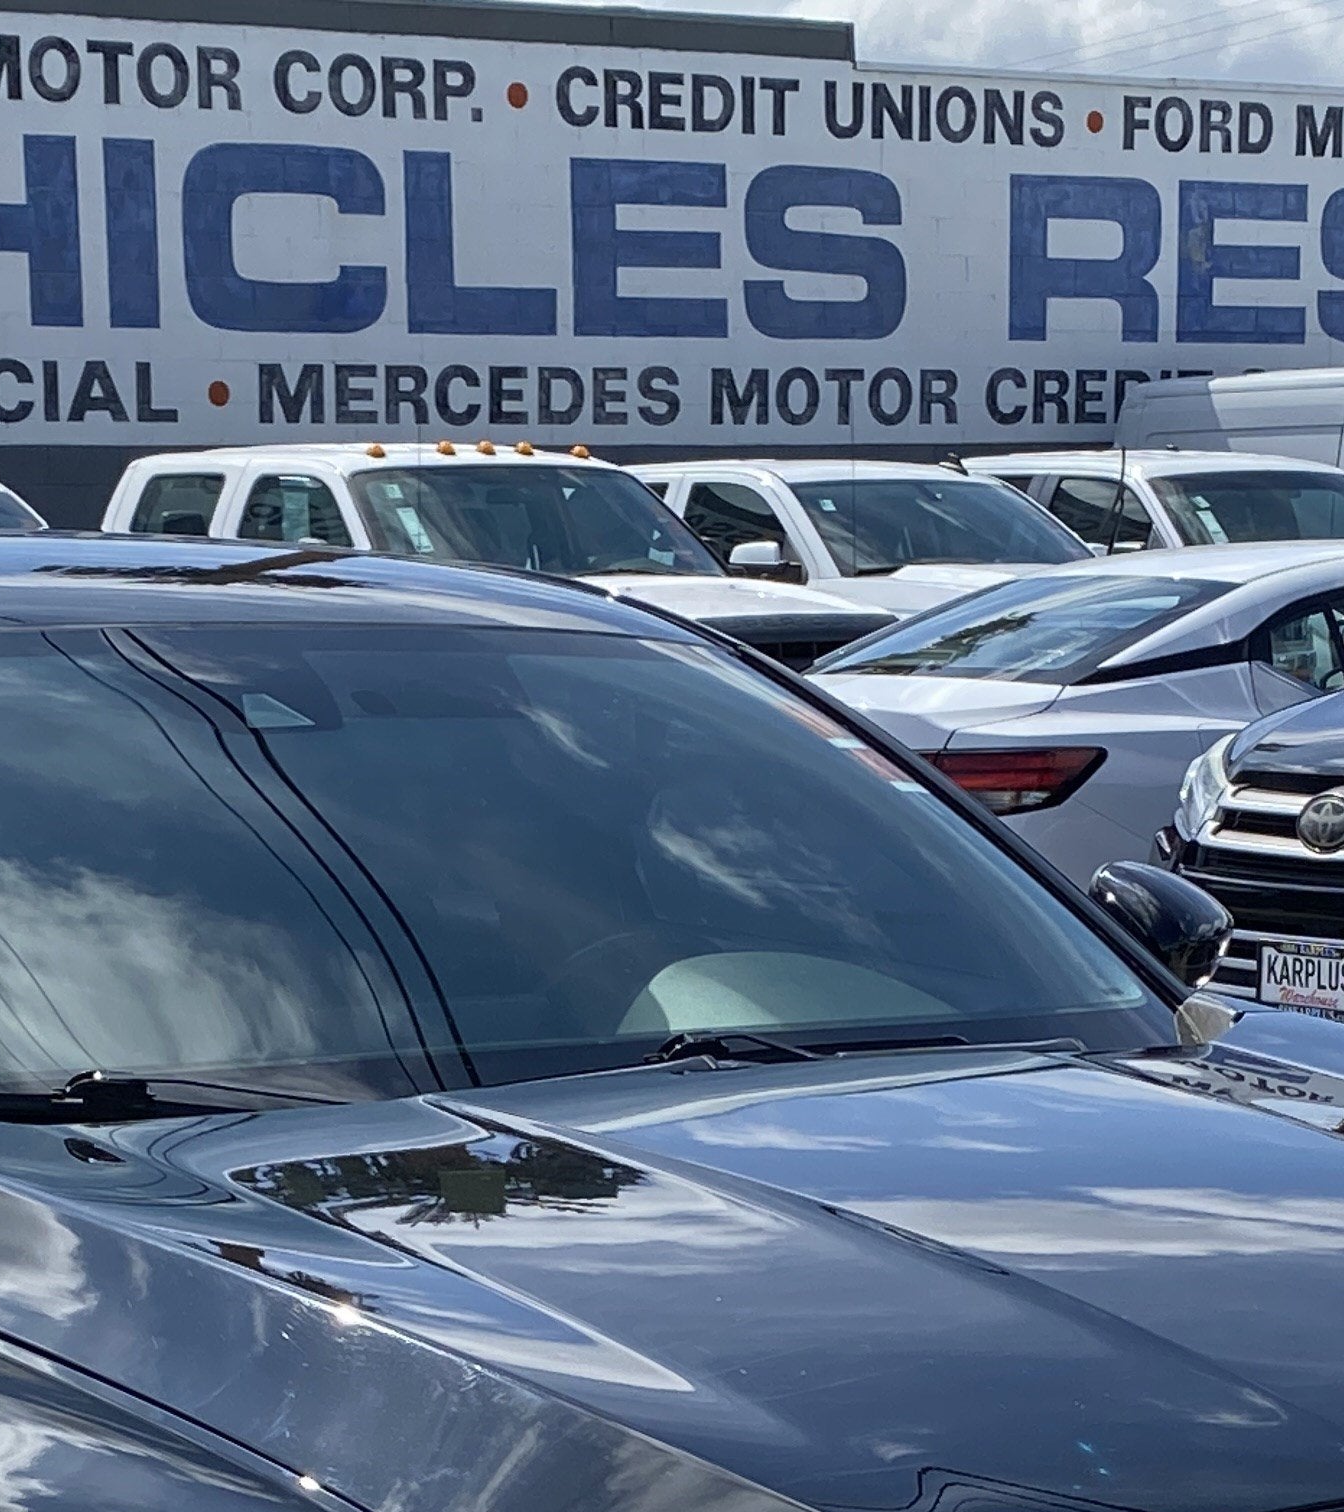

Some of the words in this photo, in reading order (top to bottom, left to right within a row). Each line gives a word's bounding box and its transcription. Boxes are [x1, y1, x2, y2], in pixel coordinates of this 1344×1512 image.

[273, 49, 483, 122] CORP.
[556, 66, 800, 136] CREDIT
[824, 80, 1065, 148] UNIONS
[1122, 96, 1274, 155] FORD
[257, 363, 681, 427] MERCEDES
[709, 367, 959, 426] MOTOR
[985, 367, 1214, 425] CRE
